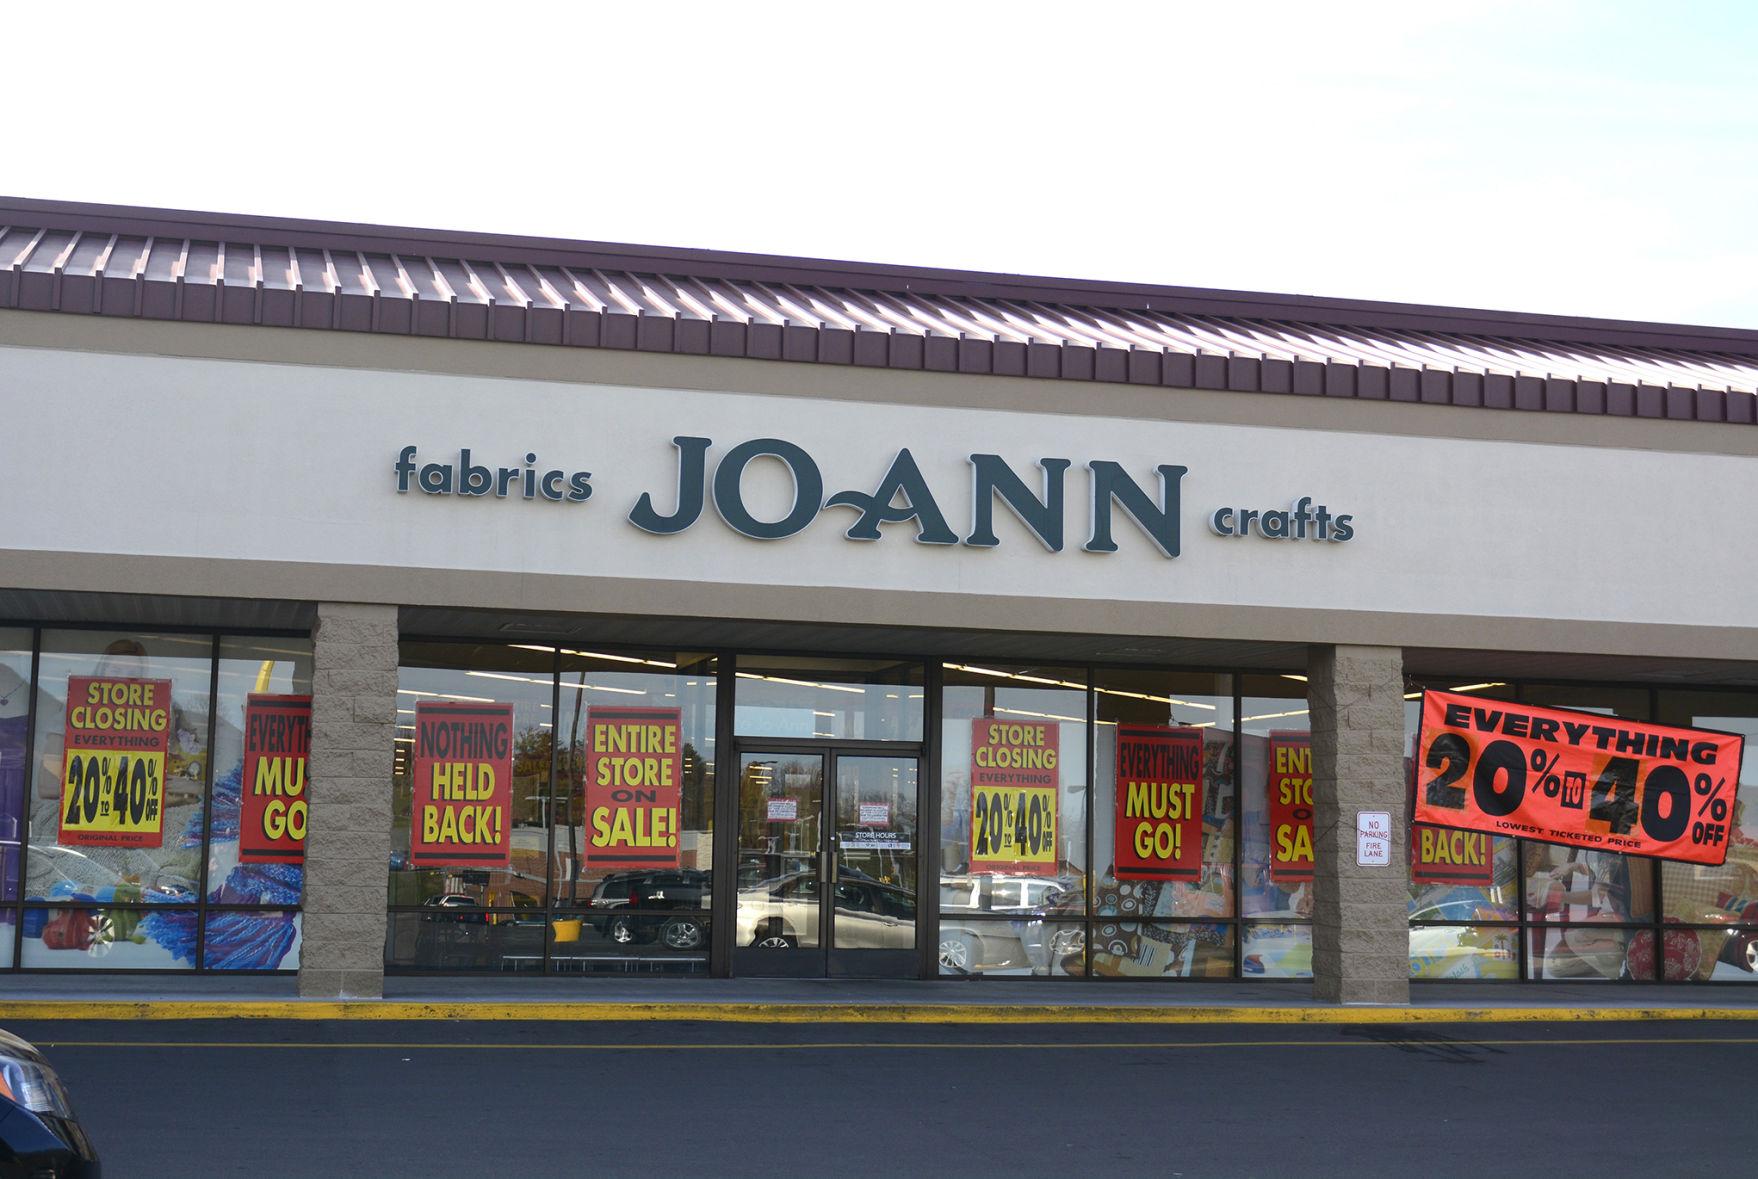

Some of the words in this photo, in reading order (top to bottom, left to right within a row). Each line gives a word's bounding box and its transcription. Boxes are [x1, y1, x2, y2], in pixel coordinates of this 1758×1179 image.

[395, 445, 593, 501] fabrics
[1209, 496, 1354, 543] crafts
[87, 681, 155, 706] STORE
[71, 706, 167, 732] CLOSING
[249, 713, 312, 752] EVERYT
[987, 724, 1045, 747] STORE
[1445, 703, 1719, 765] EVERYTHING
[75, 735, 160, 747] EVERYTHING
[420, 721, 508, 760] NOTHING
[593, 724, 676, 753] ENTIRE
[596, 757, 673, 787] STORE
[975, 746, 1057, 769] CLOSING
[1119, 742, 1199, 780] EVERYTHING
[65, 755, 112, 825] 20%
[101, 801, 110, 814] TO
[113, 756, 158, 825] 40%
[146, 798, 158, 821] OFF
[254, 756, 305, 797] MU
[432, 762, 495, 801] HELD
[979, 772, 1051, 784] EVERYTHING
[1426, 732, 1560, 817] 20%
[1563, 775, 1584, 808] TO
[1589, 755, 1727, 842] 40%
[1691, 822, 1725, 848] OFF
[611, 789, 657, 802] ON
[1125, 782, 1195, 820] MUST
[1292, 808, 1312, 820] O
[78, 833, 117, 841] ORIGINAL
[119, 834, 144, 842] PRICE
[263, 799, 308, 840] GO
[422, 805, 501, 844] BACK!
[591, 808, 677, 848] SALE!
[975, 791, 1013, 855] 20%
[1004, 833, 1012, 845] TO
[1015, 792, 1052, 856] 40%
[1360, 830, 1388, 839] PARKING
[1368, 821, 1380, 830] NO
[1496, 820, 1544, 834] LOWEST
[1550, 829, 1602, 843] TICKETED
[1607, 837, 1641, 848] PRICE
[1134, 823, 1182, 860] GO!
[1420, 829, 1486, 865] BACK!
